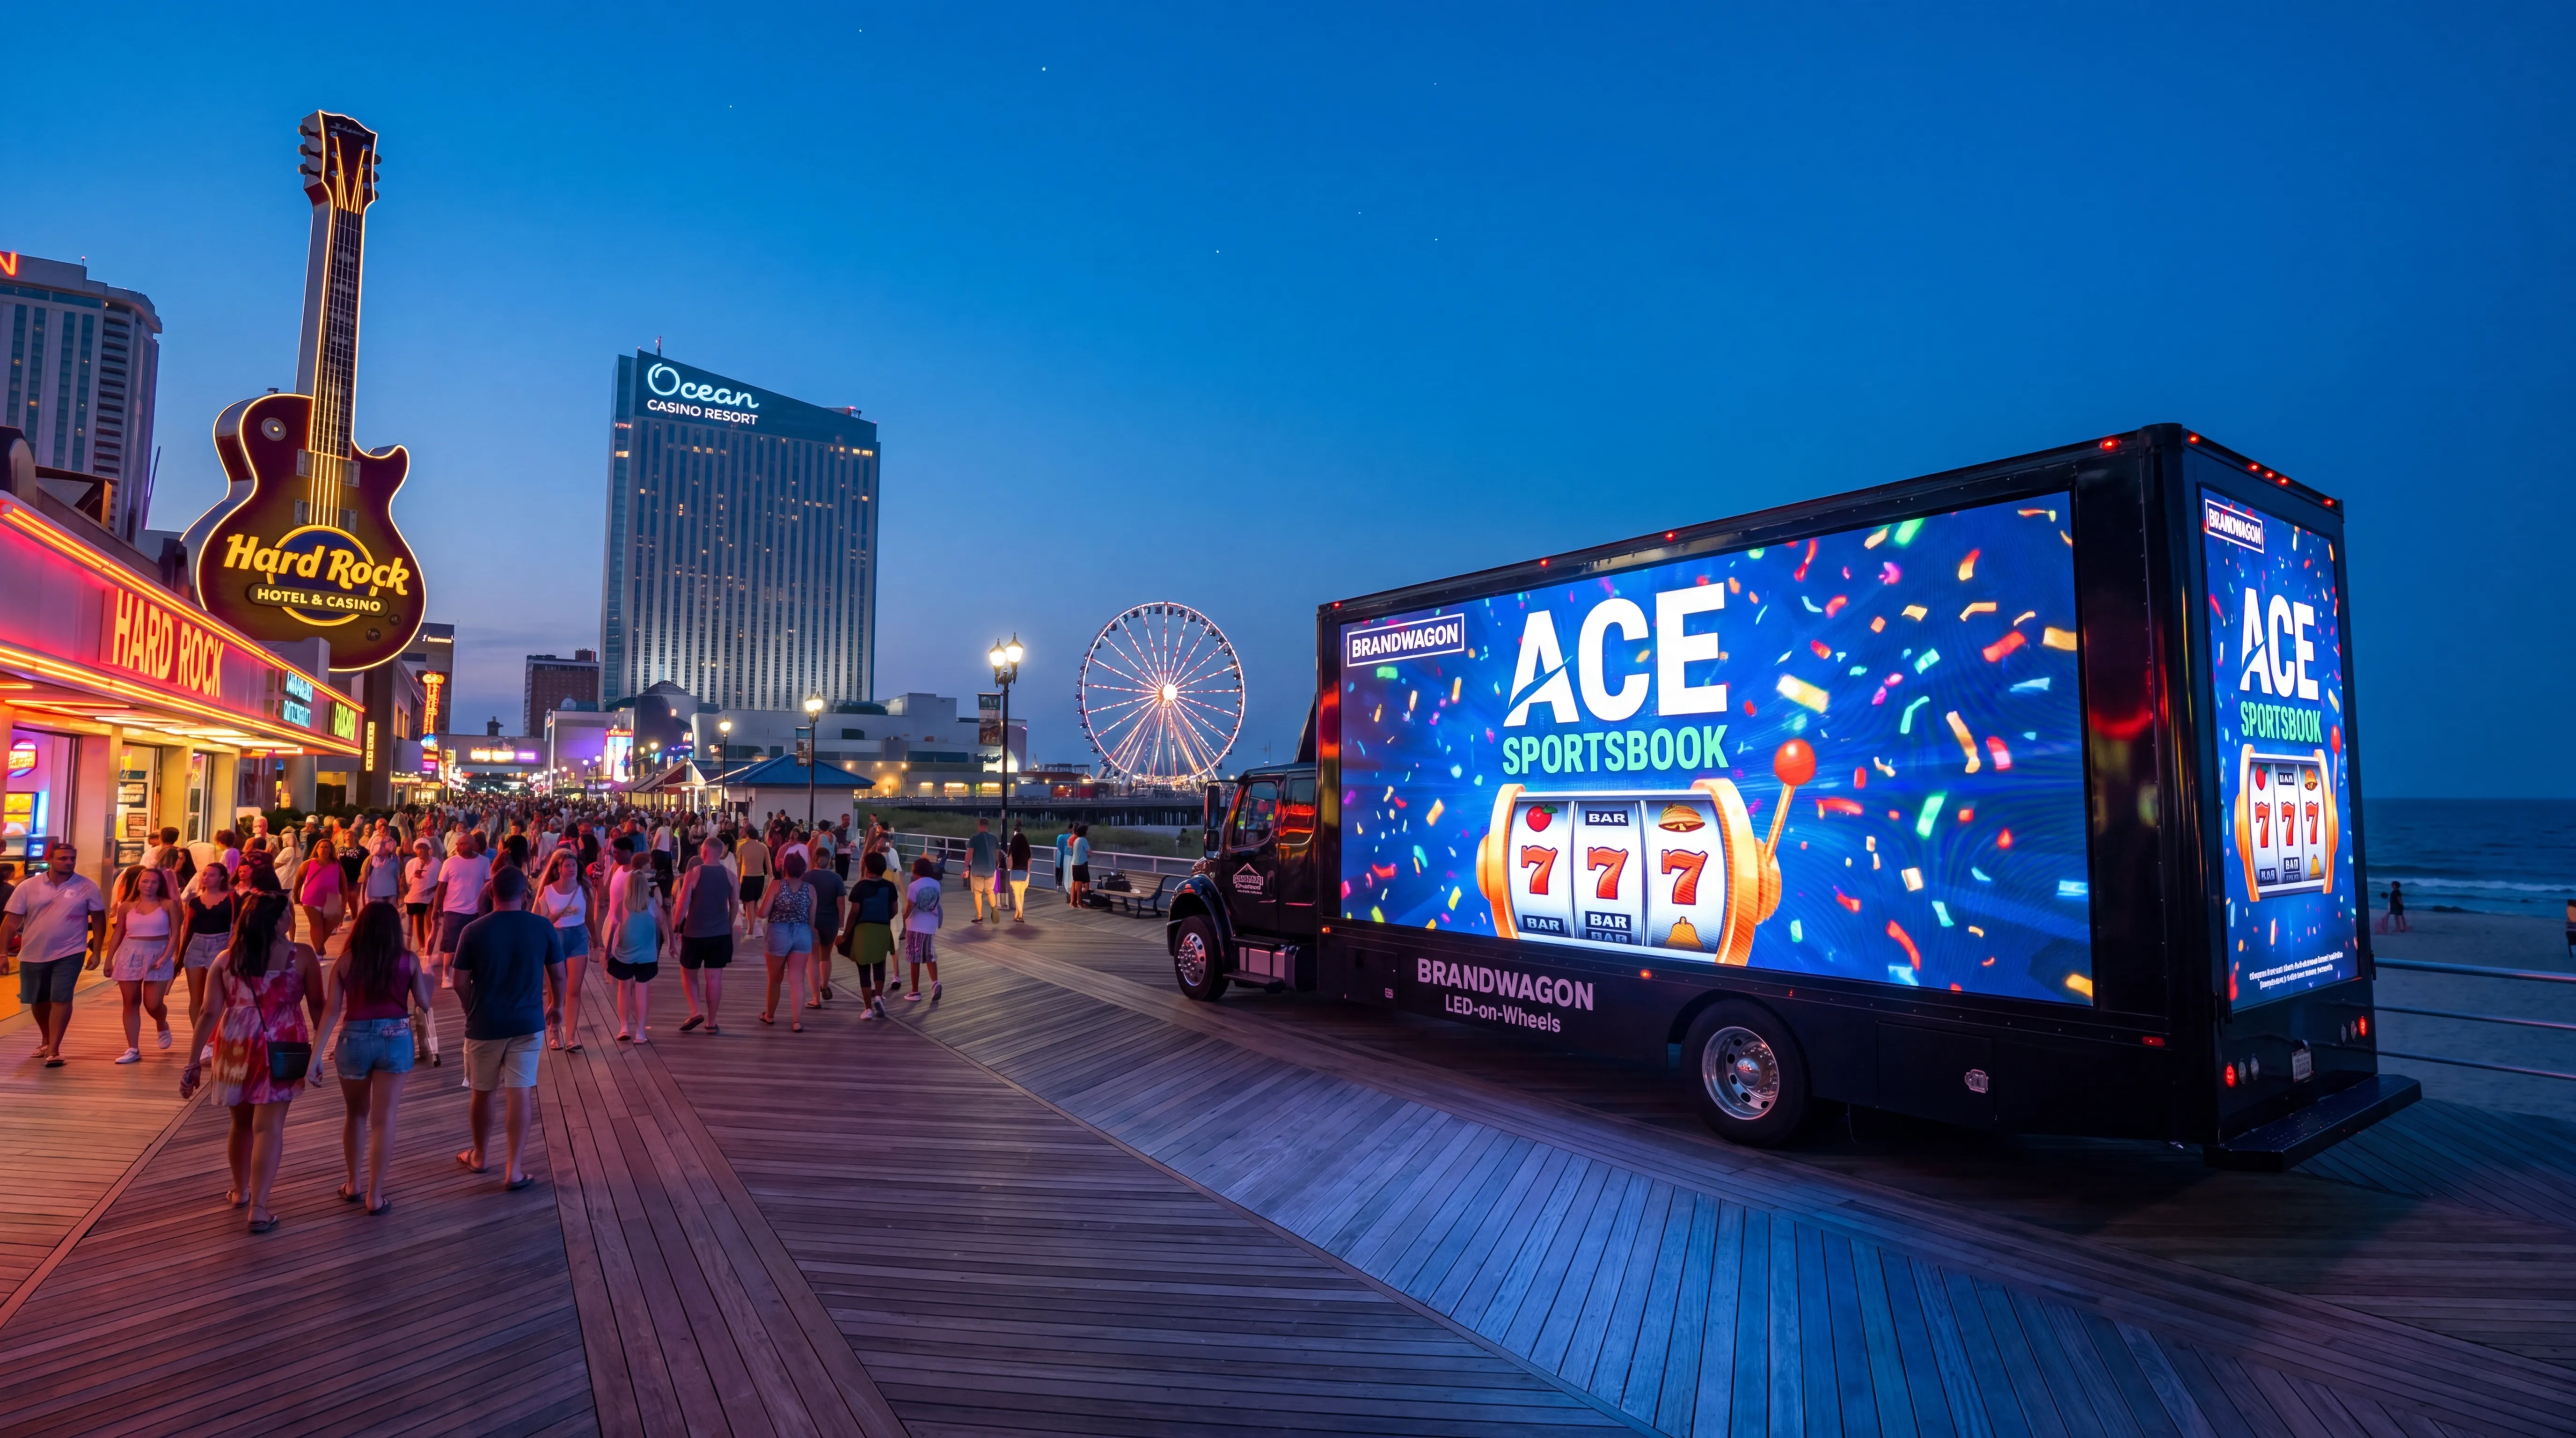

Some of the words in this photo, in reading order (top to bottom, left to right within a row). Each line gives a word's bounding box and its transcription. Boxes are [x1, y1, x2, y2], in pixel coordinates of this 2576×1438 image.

[647, 363, 759, 408] Ocean
[647, 400, 701, 417] CASINO
[704, 408, 758, 426] RESORT
[224, 533, 325, 579] Hard
[326, 549, 410, 596] Rock
[257, 588, 307, 605] HOTEL
[311, 594, 322, 606] &
[326, 596, 381, 612] CASINO
[112, 588, 173, 680] HARD
[177, 621, 224, 698] ROCK
[1352, 623, 1459, 658] BRANDWAGON
[1503, 583, 1727, 726] ACE
[2239, 587, 2319, 701] ACE
[2240, 701, 2322, 743] SPORTSBOOK
[1503, 725, 1729, 775] SPORTSBOOK
[1589, 814, 1626, 823] BAR
[2255, 801, 2270, 848] 7
[2281, 801, 2295, 846] 7
[2305, 800, 2319, 844] 7
[1521, 845, 1558, 895] 7
[1588, 847, 1629, 900] 7
[1661, 849, 1708, 905] 7
[1527, 918, 1559, 931] BAR
[1590, 914, 1627, 929] BAR
[1418, 958, 1594, 1011] BRANDWAGON
[1446, 994, 1561, 1033] LED-on-Wheels
